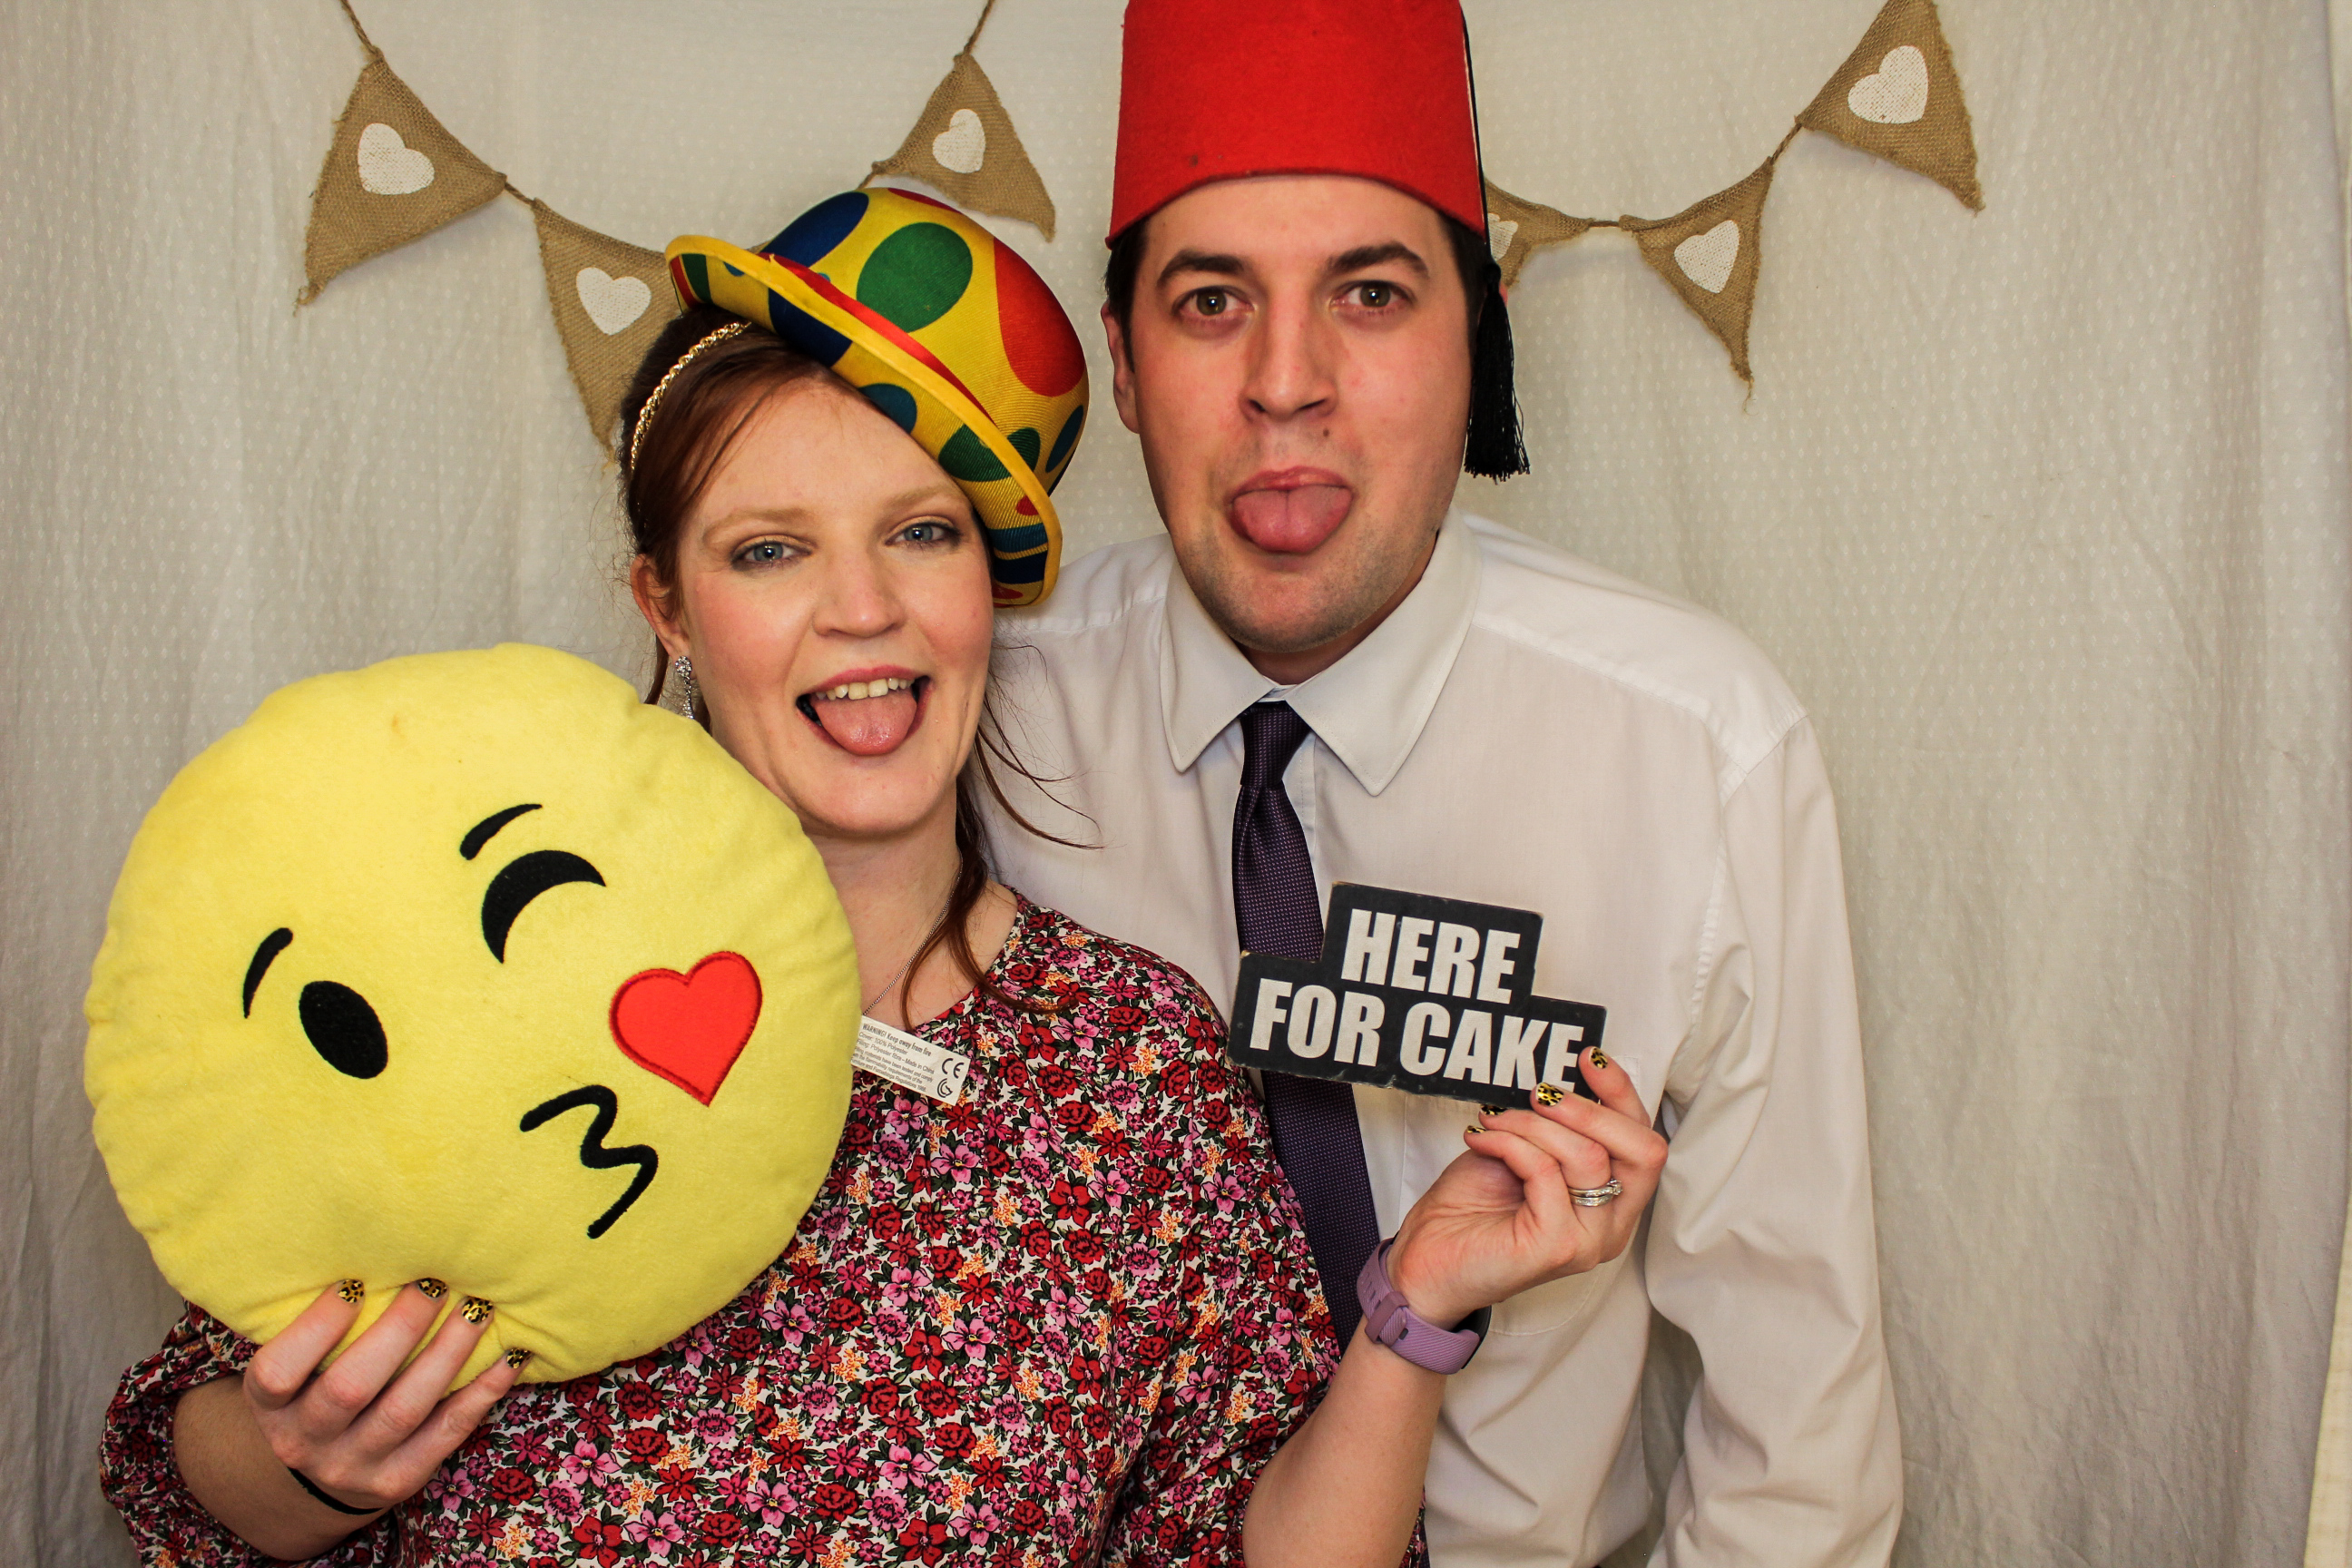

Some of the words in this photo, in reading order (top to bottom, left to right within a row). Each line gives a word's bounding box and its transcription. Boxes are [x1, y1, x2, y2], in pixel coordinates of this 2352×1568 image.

[1341, 908, 1521, 1004] HERE
[886, 1033, 899, 1044] Keep
[897, 1039, 912, 1050] away
[911, 1042, 924, 1053] from
[922, 1047, 933, 1056] fire
[1250, 977, 1386, 1067] FOR
[1399, 1002, 1584, 1093] CAKE
[942, 1058, 964, 1078] CE
